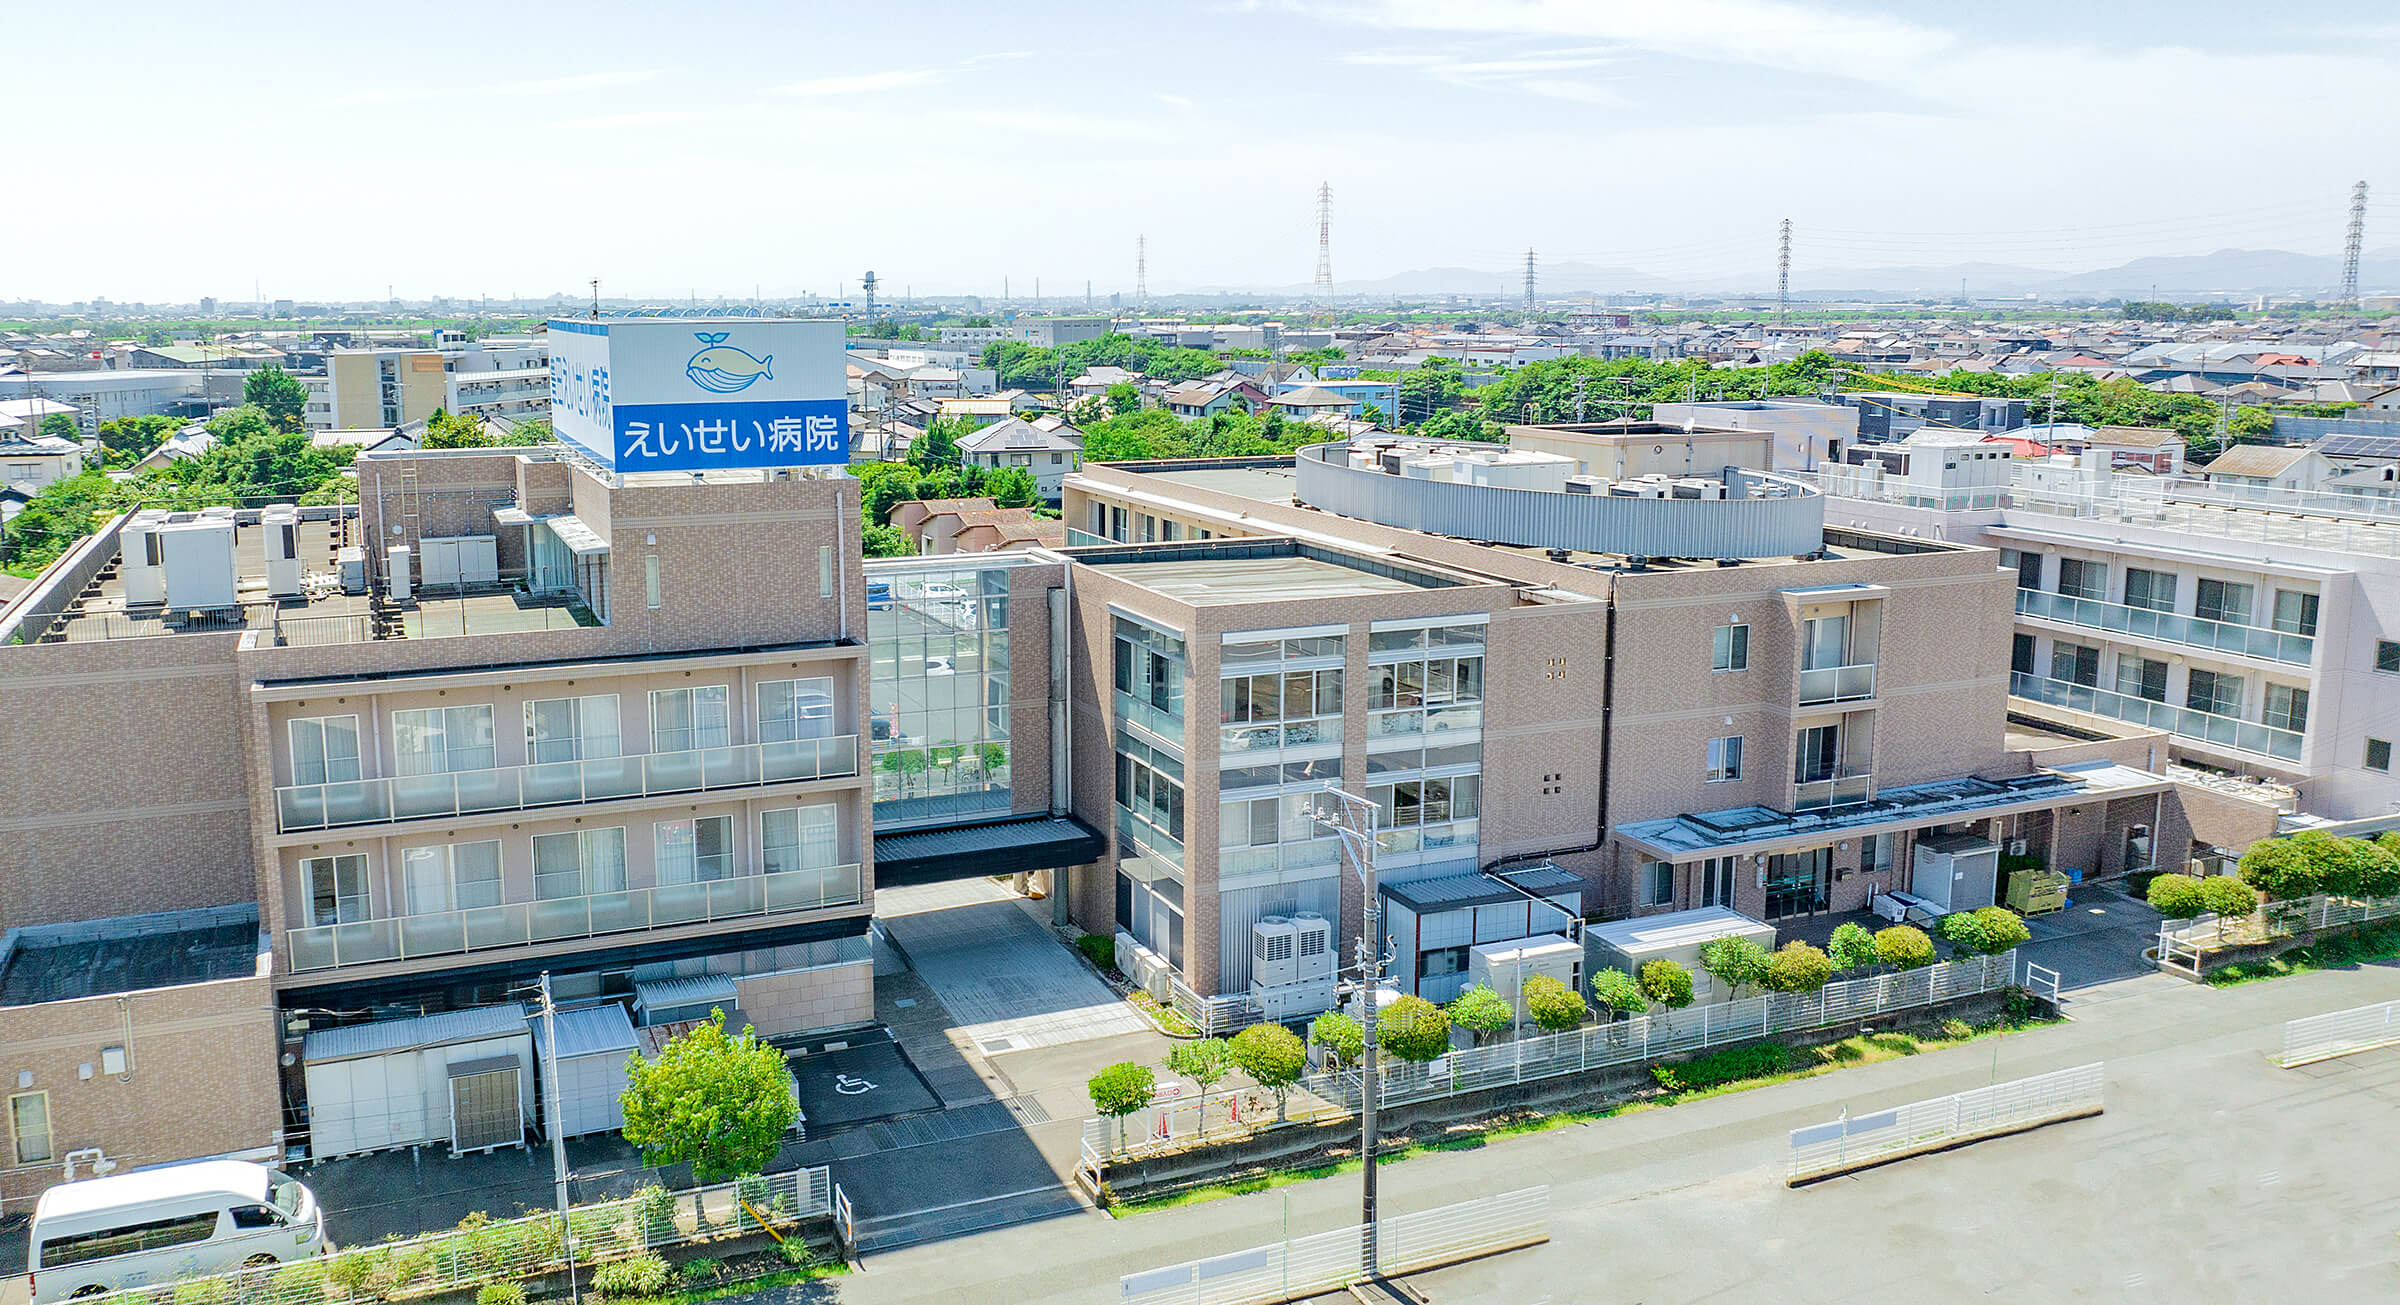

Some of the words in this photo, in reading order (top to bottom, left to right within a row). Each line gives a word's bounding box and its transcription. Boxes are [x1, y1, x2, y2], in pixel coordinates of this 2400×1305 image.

[624, 414, 839, 458] えいせい病院
